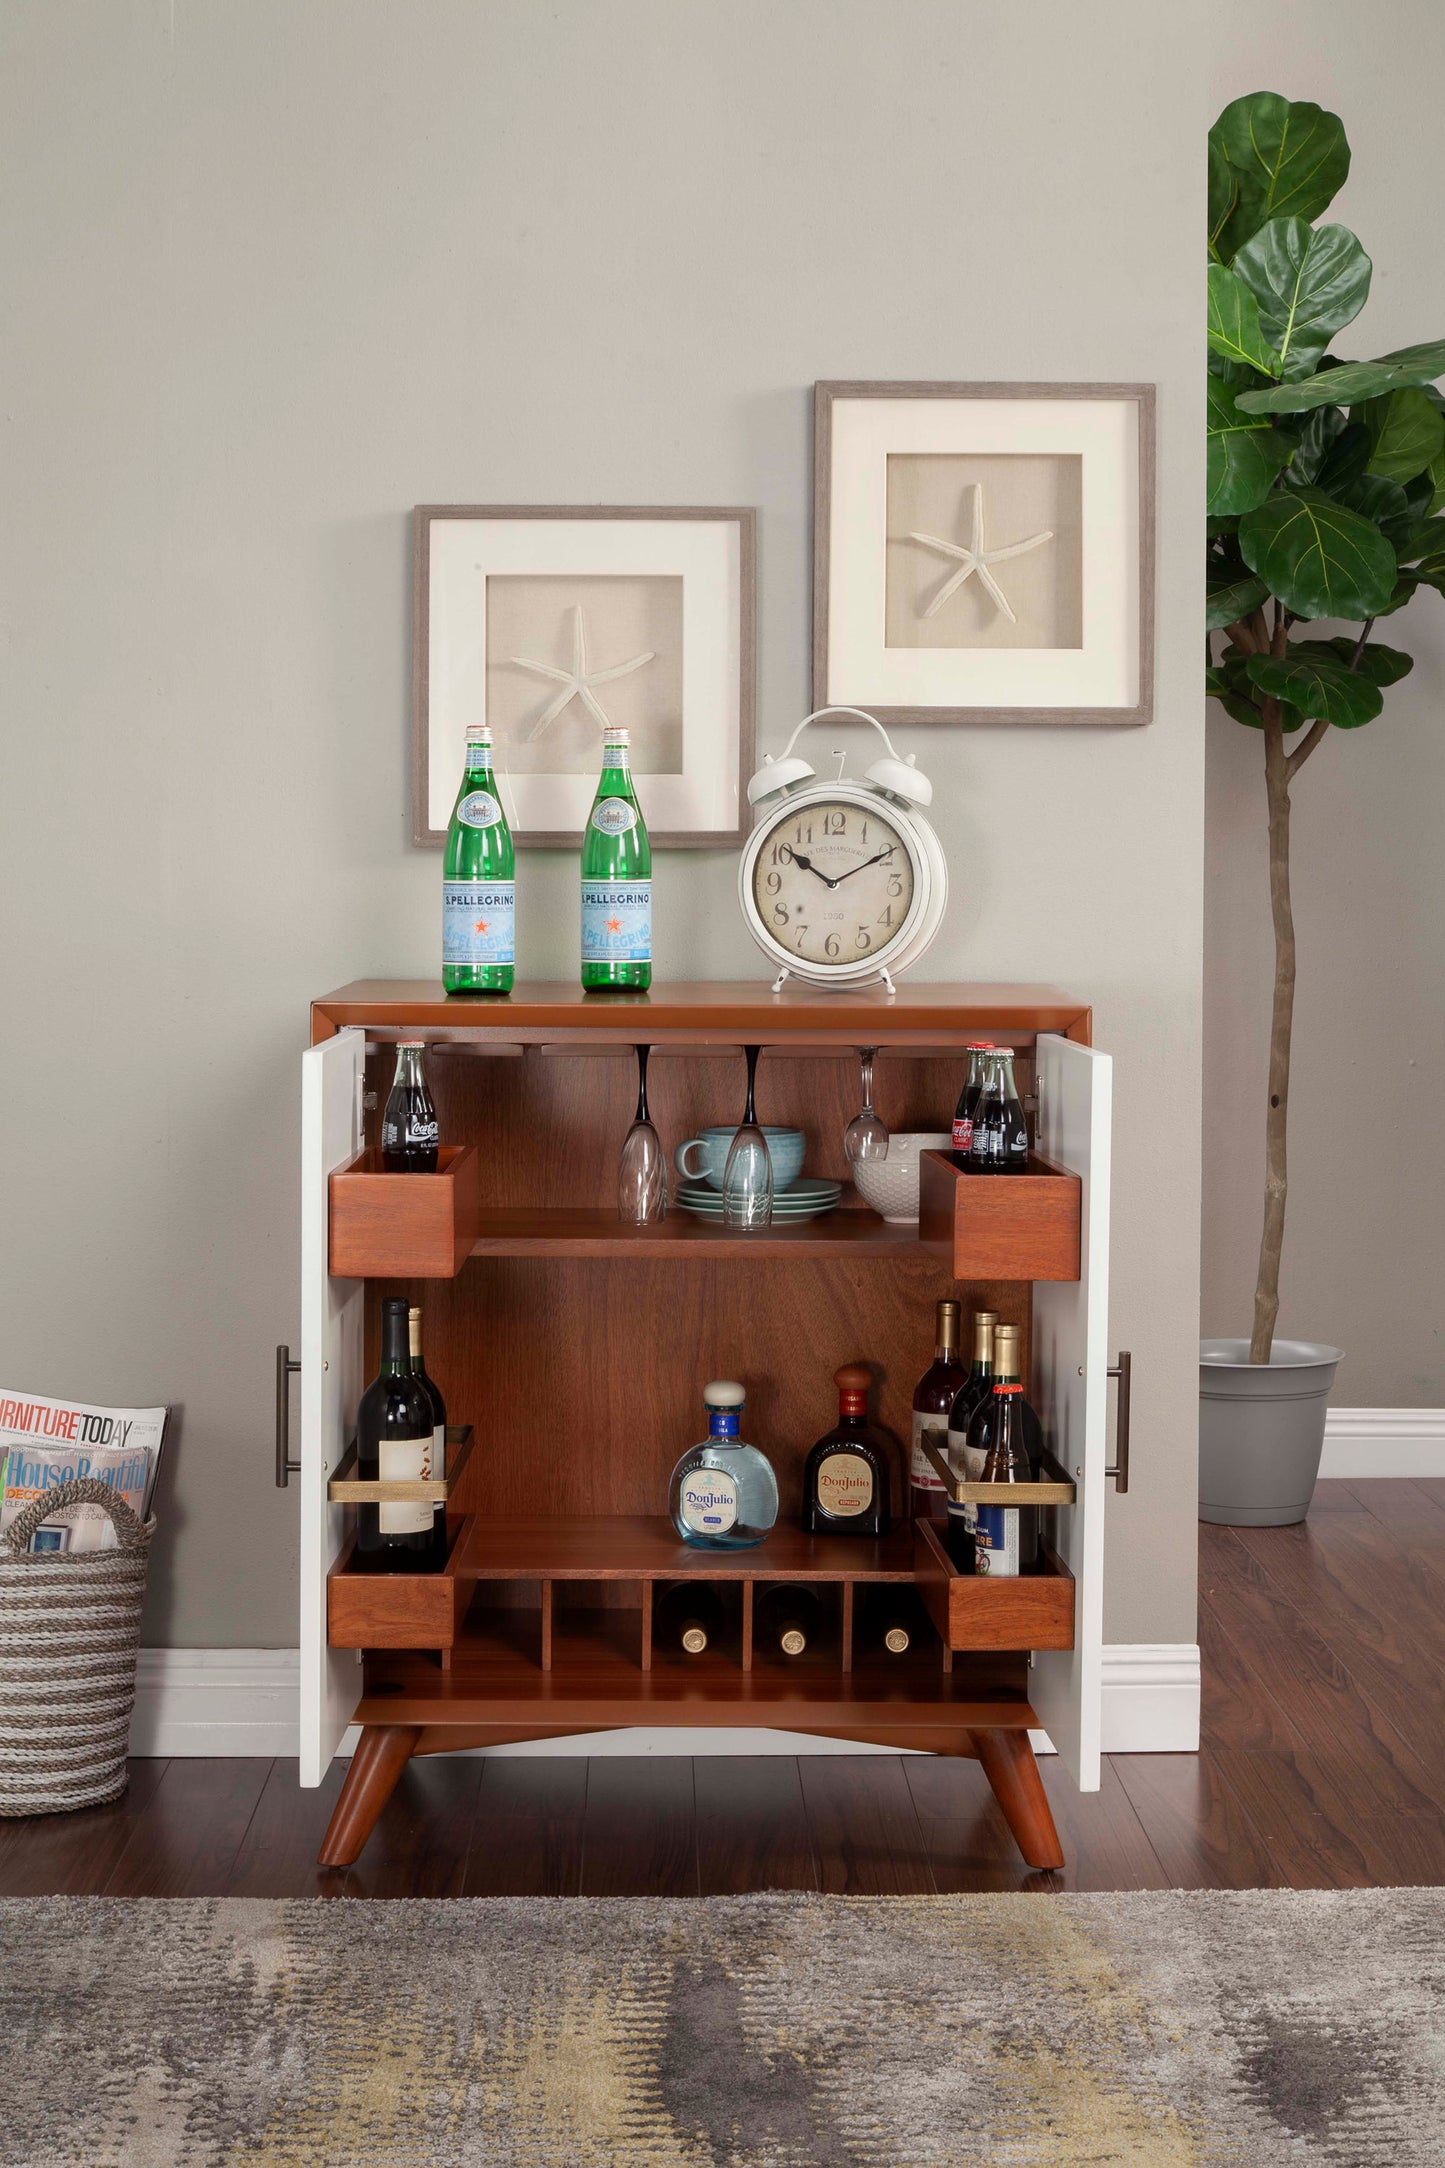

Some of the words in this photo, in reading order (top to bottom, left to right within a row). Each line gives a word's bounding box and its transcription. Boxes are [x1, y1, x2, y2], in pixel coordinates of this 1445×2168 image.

[796, 822, 814, 844] 11
[823, 812, 845, 836] 12
[860, 821, 869, 844] 1
[771, 842, 793, 866] 10
[766, 872, 782, 896] 9
[886, 873, 903, 897] 3
[773, 902, 789, 926] 8
[877, 904, 894, 927] 4
[794, 925, 810, 948] 7
[824, 932, 840, 957] 6
[854, 926, 871, 949] 5
[81, 1413, 133, 1448] TODAY
[7, 1452, 74, 1489] House
[76, 1454, 147, 1492] Beautiful
[5, 1487, 46, 1500] DECO
[49, 1511, 80, 1520] BOSTON
